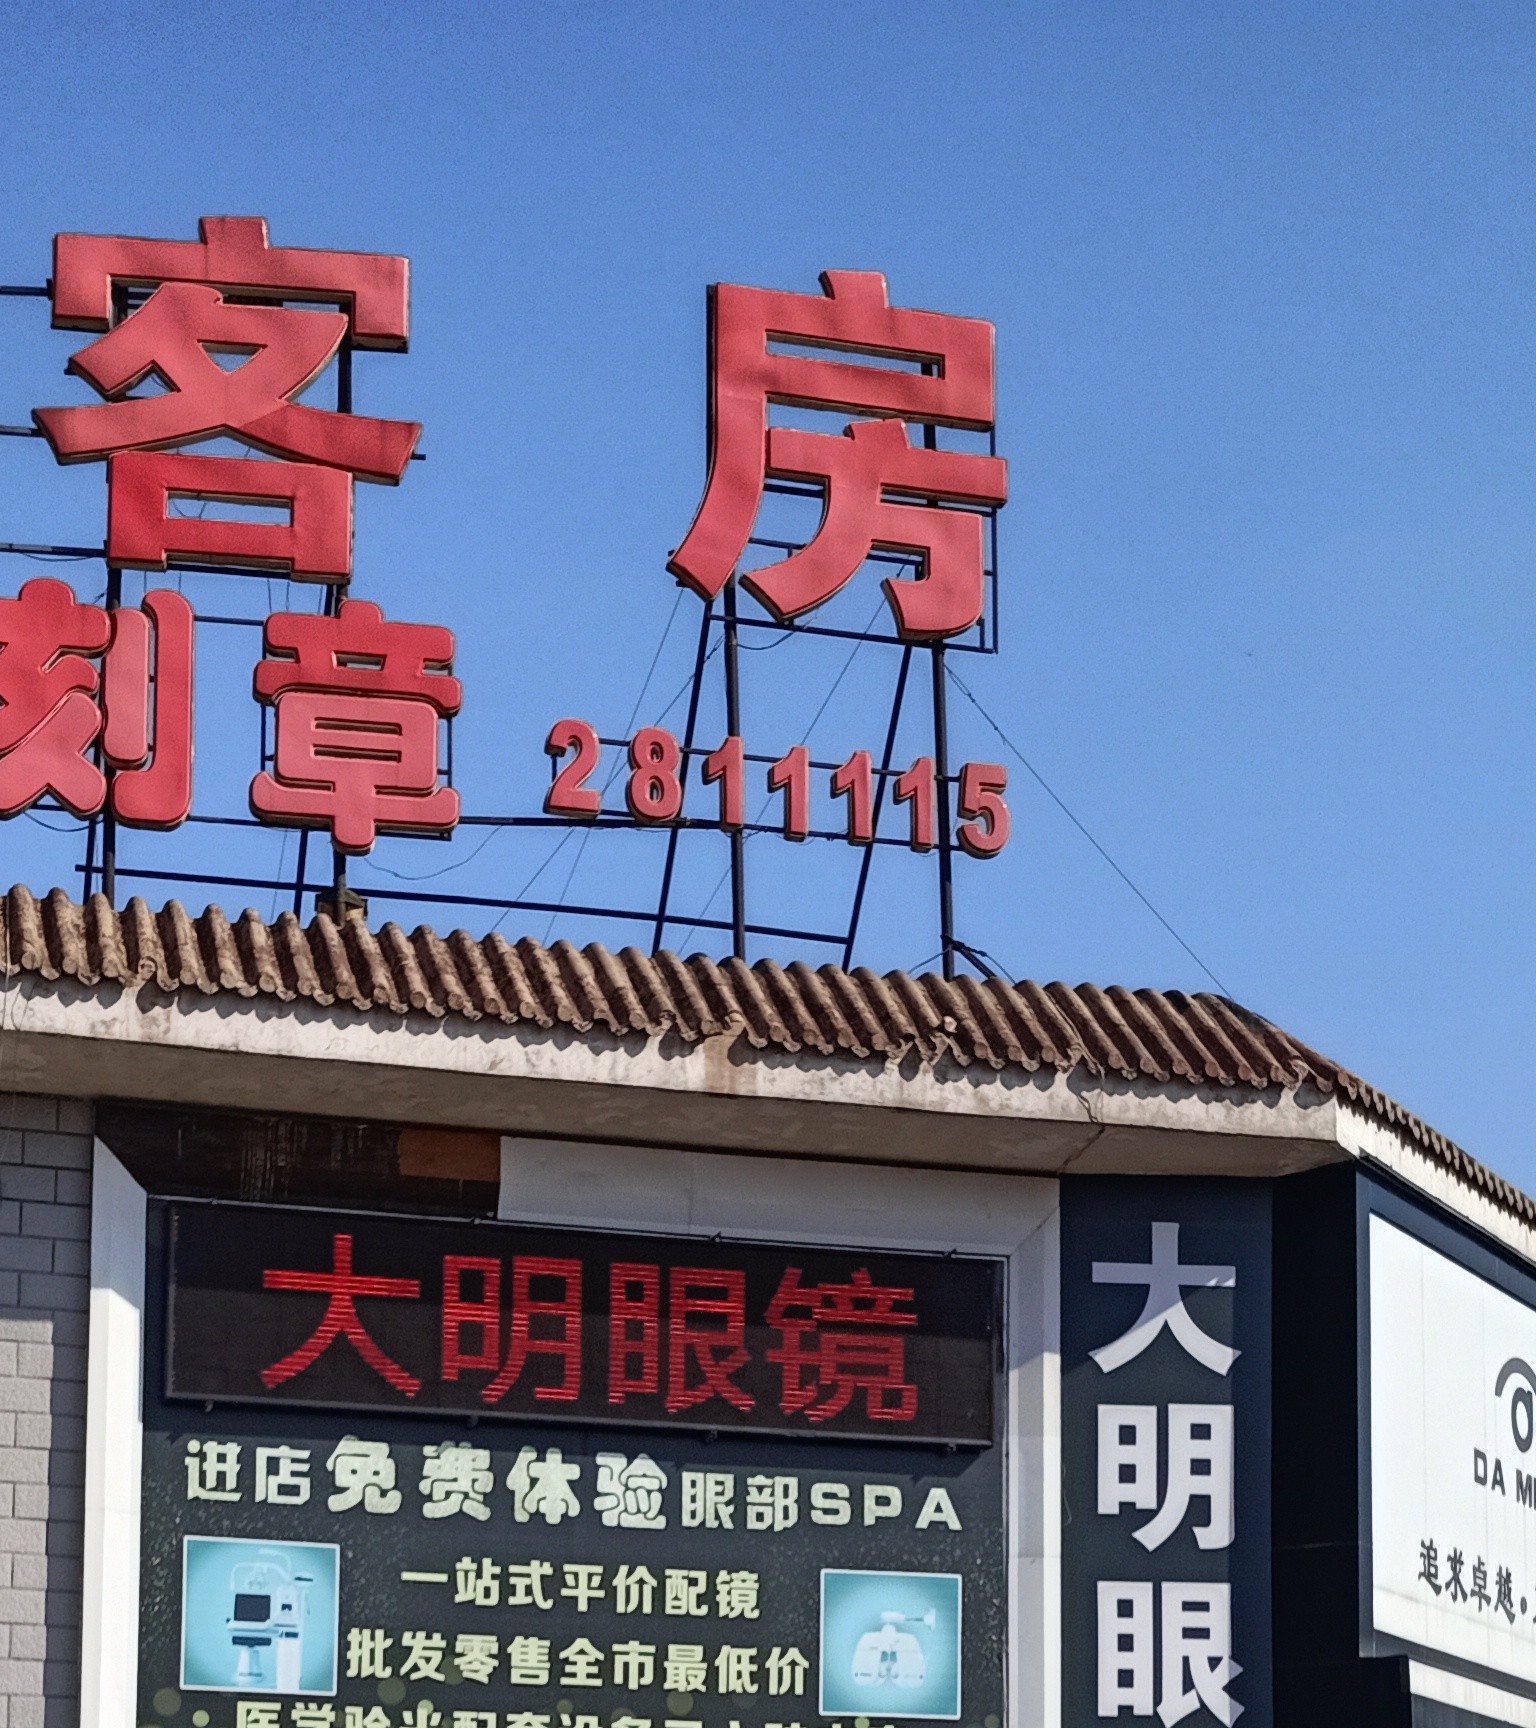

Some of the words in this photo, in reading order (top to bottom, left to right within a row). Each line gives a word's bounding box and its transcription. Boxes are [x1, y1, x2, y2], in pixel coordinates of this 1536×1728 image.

[31, 216, 1008, 640] 客房
[543, 717, 1012, 860] 2811115
[260, 1231, 920, 1423] 大明眼镜
[184, 1434, 963, 1532] 进店免费体验眼部SPA
[1473, 1446, 1506, 1497] DA
[401, 1556, 762, 1620] 一站式平价配镜
[344, 1627, 811, 1698] 批发零售全市最低价
